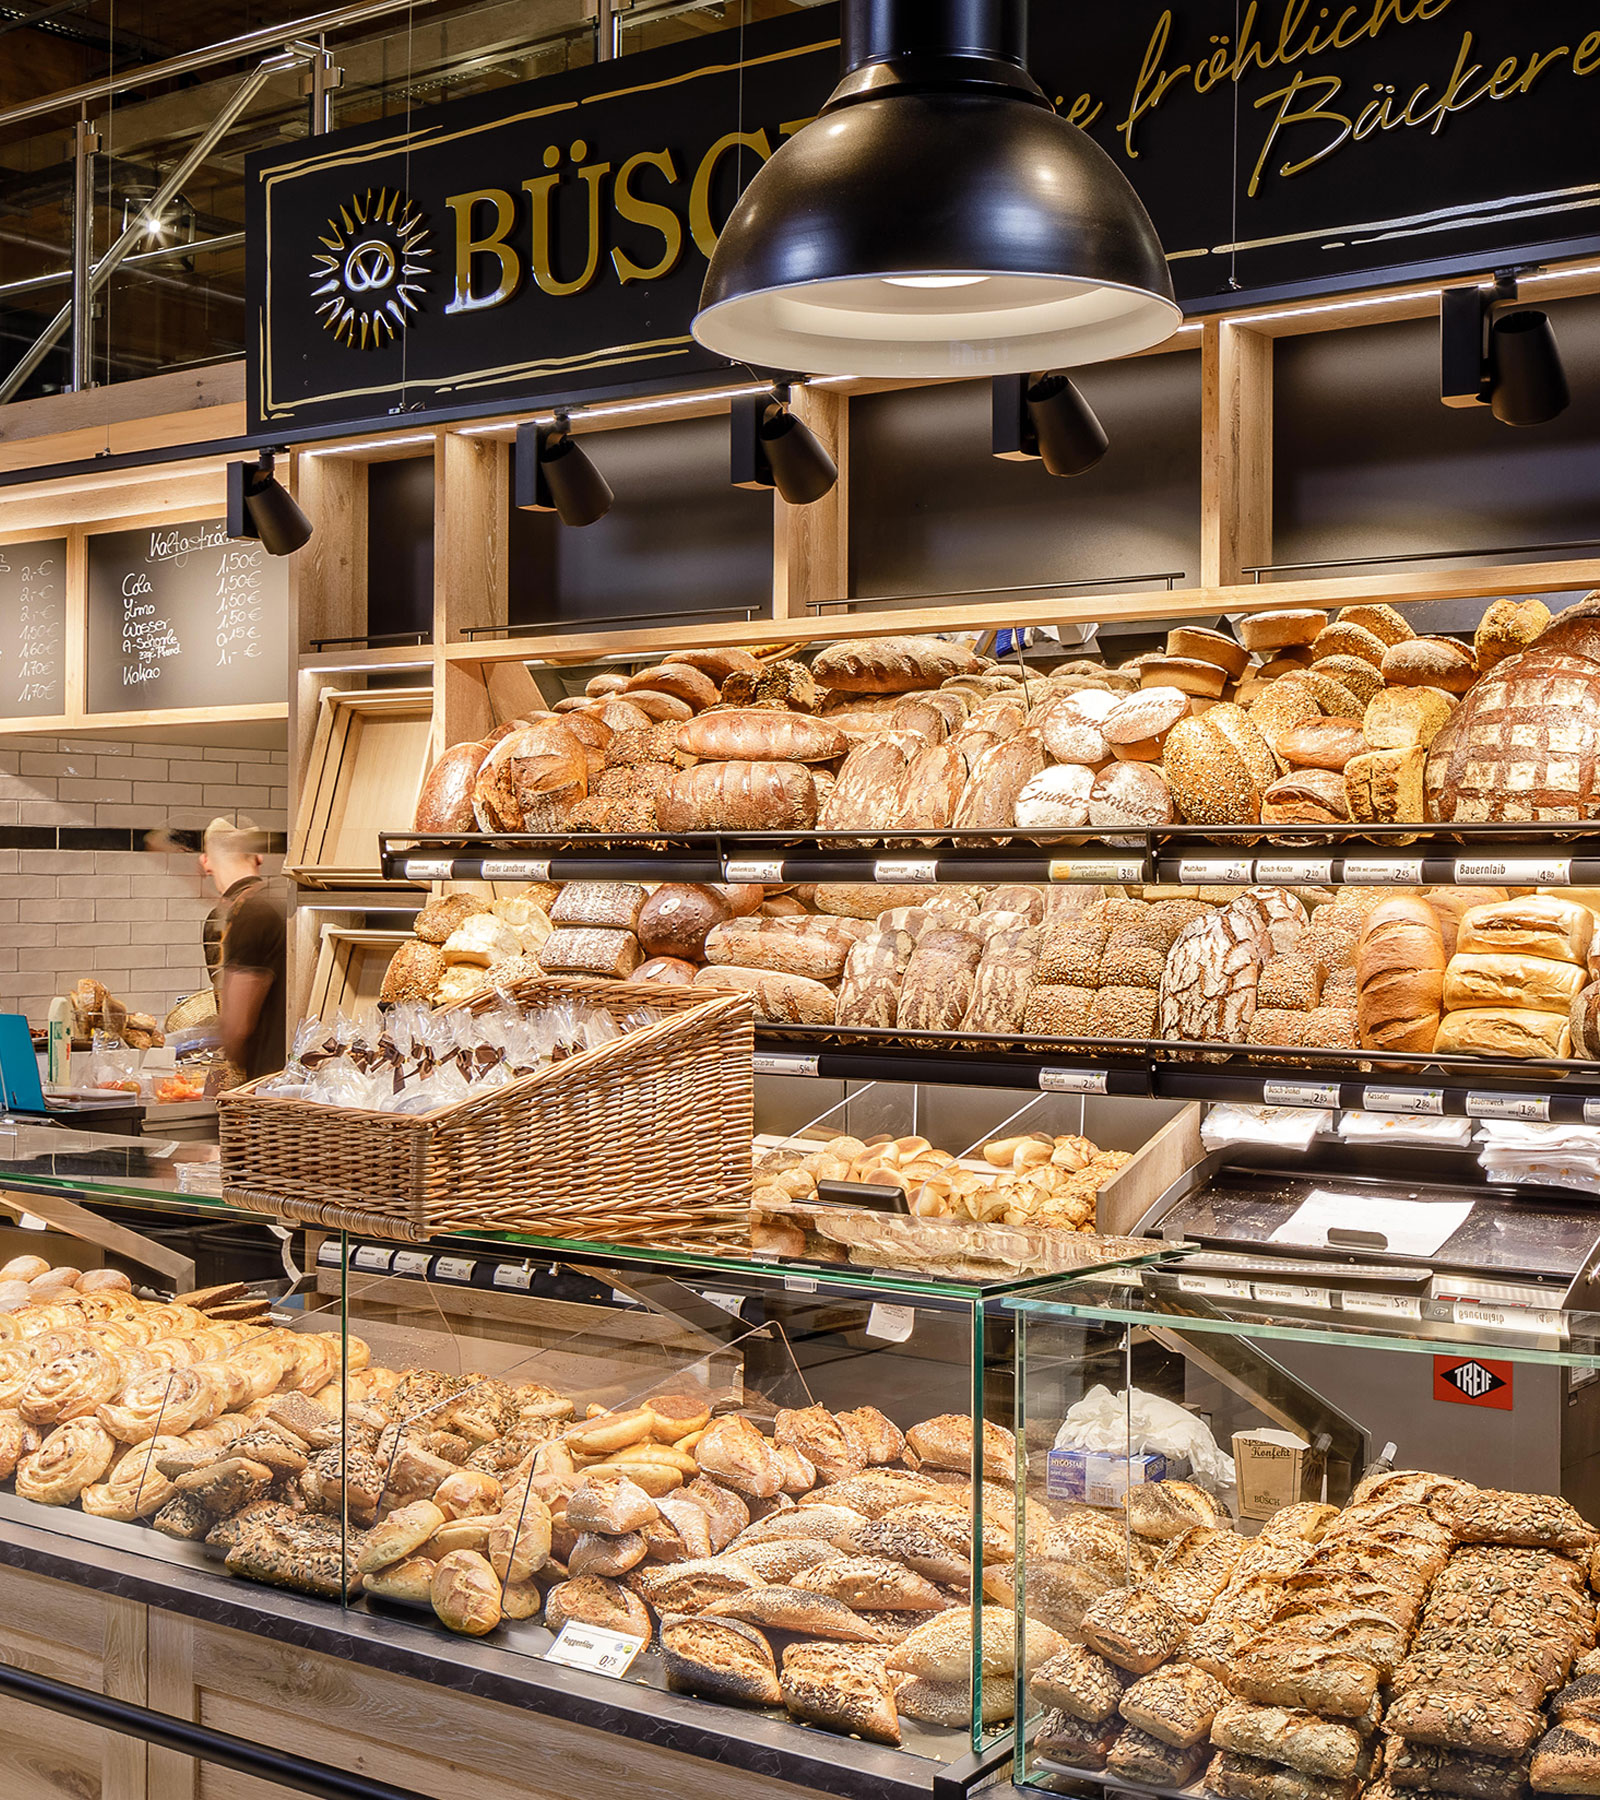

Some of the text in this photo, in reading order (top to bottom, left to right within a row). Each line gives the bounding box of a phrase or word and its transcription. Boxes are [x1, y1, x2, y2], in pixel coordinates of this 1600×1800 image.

[444, 117, 818, 315] BÜSC
[122, 572, 153, 597] Cola
[122, 618, 171, 638] Wasser
[123, 663, 161, 686] Kakao
[1459, 863, 1506, 875] Bauernlaib
[1454, 1362, 1493, 1397] TREIF
